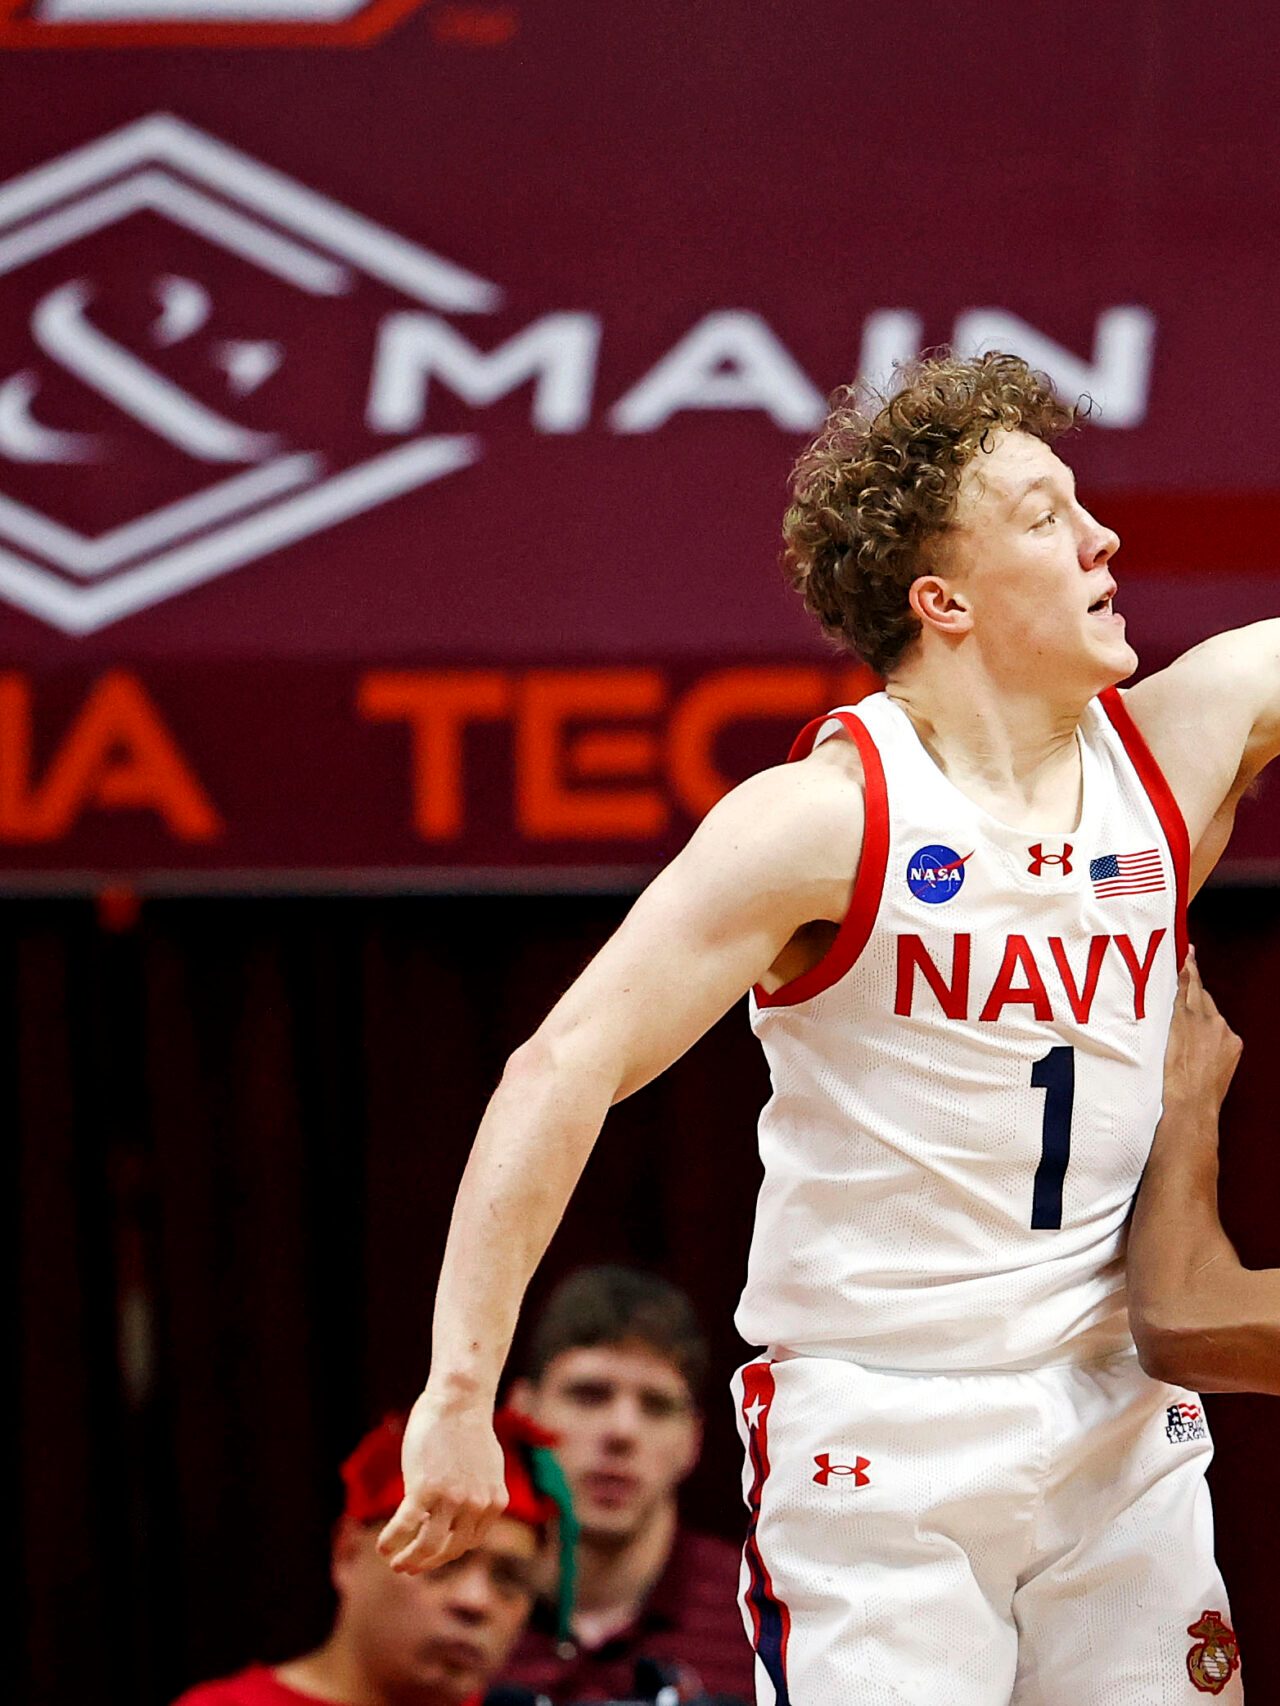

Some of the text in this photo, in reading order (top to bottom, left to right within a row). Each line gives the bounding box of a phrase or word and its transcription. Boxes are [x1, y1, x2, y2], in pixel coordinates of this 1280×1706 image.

[366, 306, 1156, 434] MAIN
[356, 666, 886, 842] TEC
[910, 867, 962, 882] NASA
[894, 928, 1167, 1024] NAVY
[1030, 1046, 1075, 1230] 1
